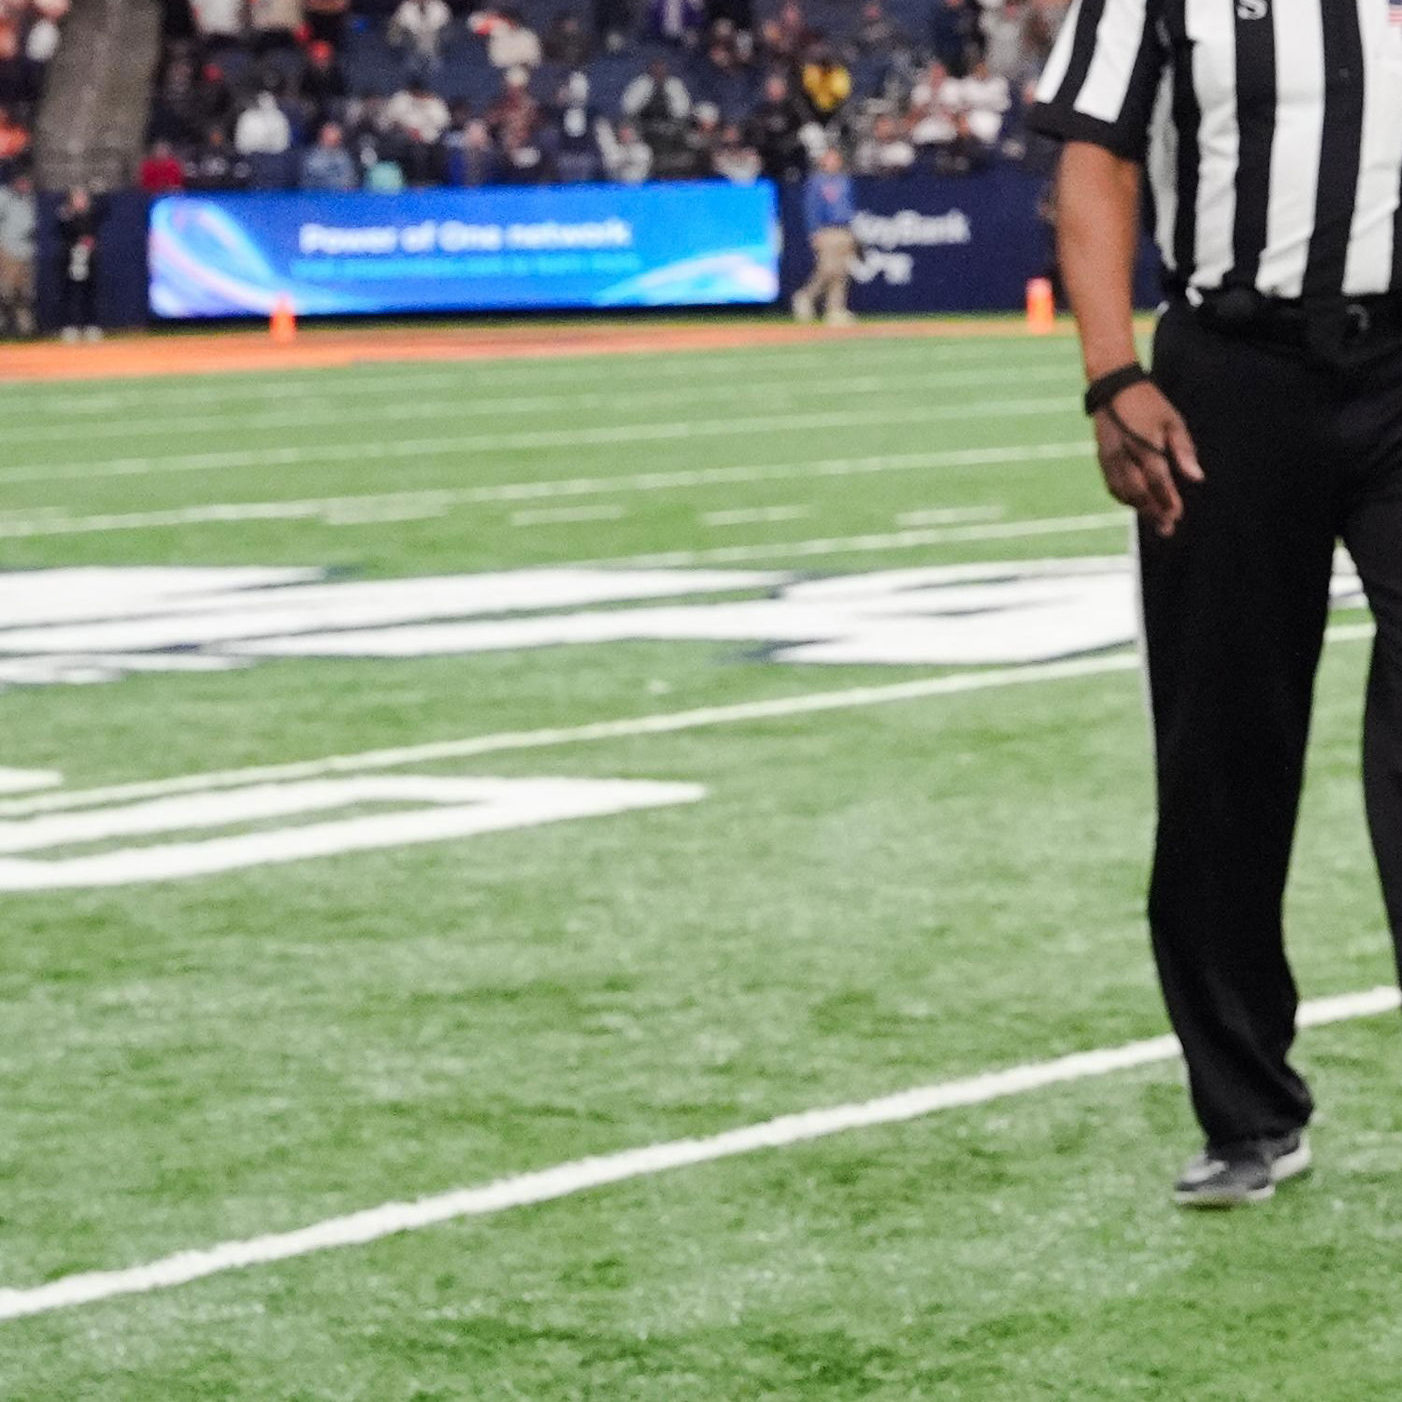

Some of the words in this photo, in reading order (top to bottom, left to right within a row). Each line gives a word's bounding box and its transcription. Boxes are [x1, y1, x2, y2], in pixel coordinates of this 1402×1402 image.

[299, 222, 397, 254] Power
[401, 219, 437, 253] of
[438, 219, 502, 253] One
[504, 216, 633, 249] network
